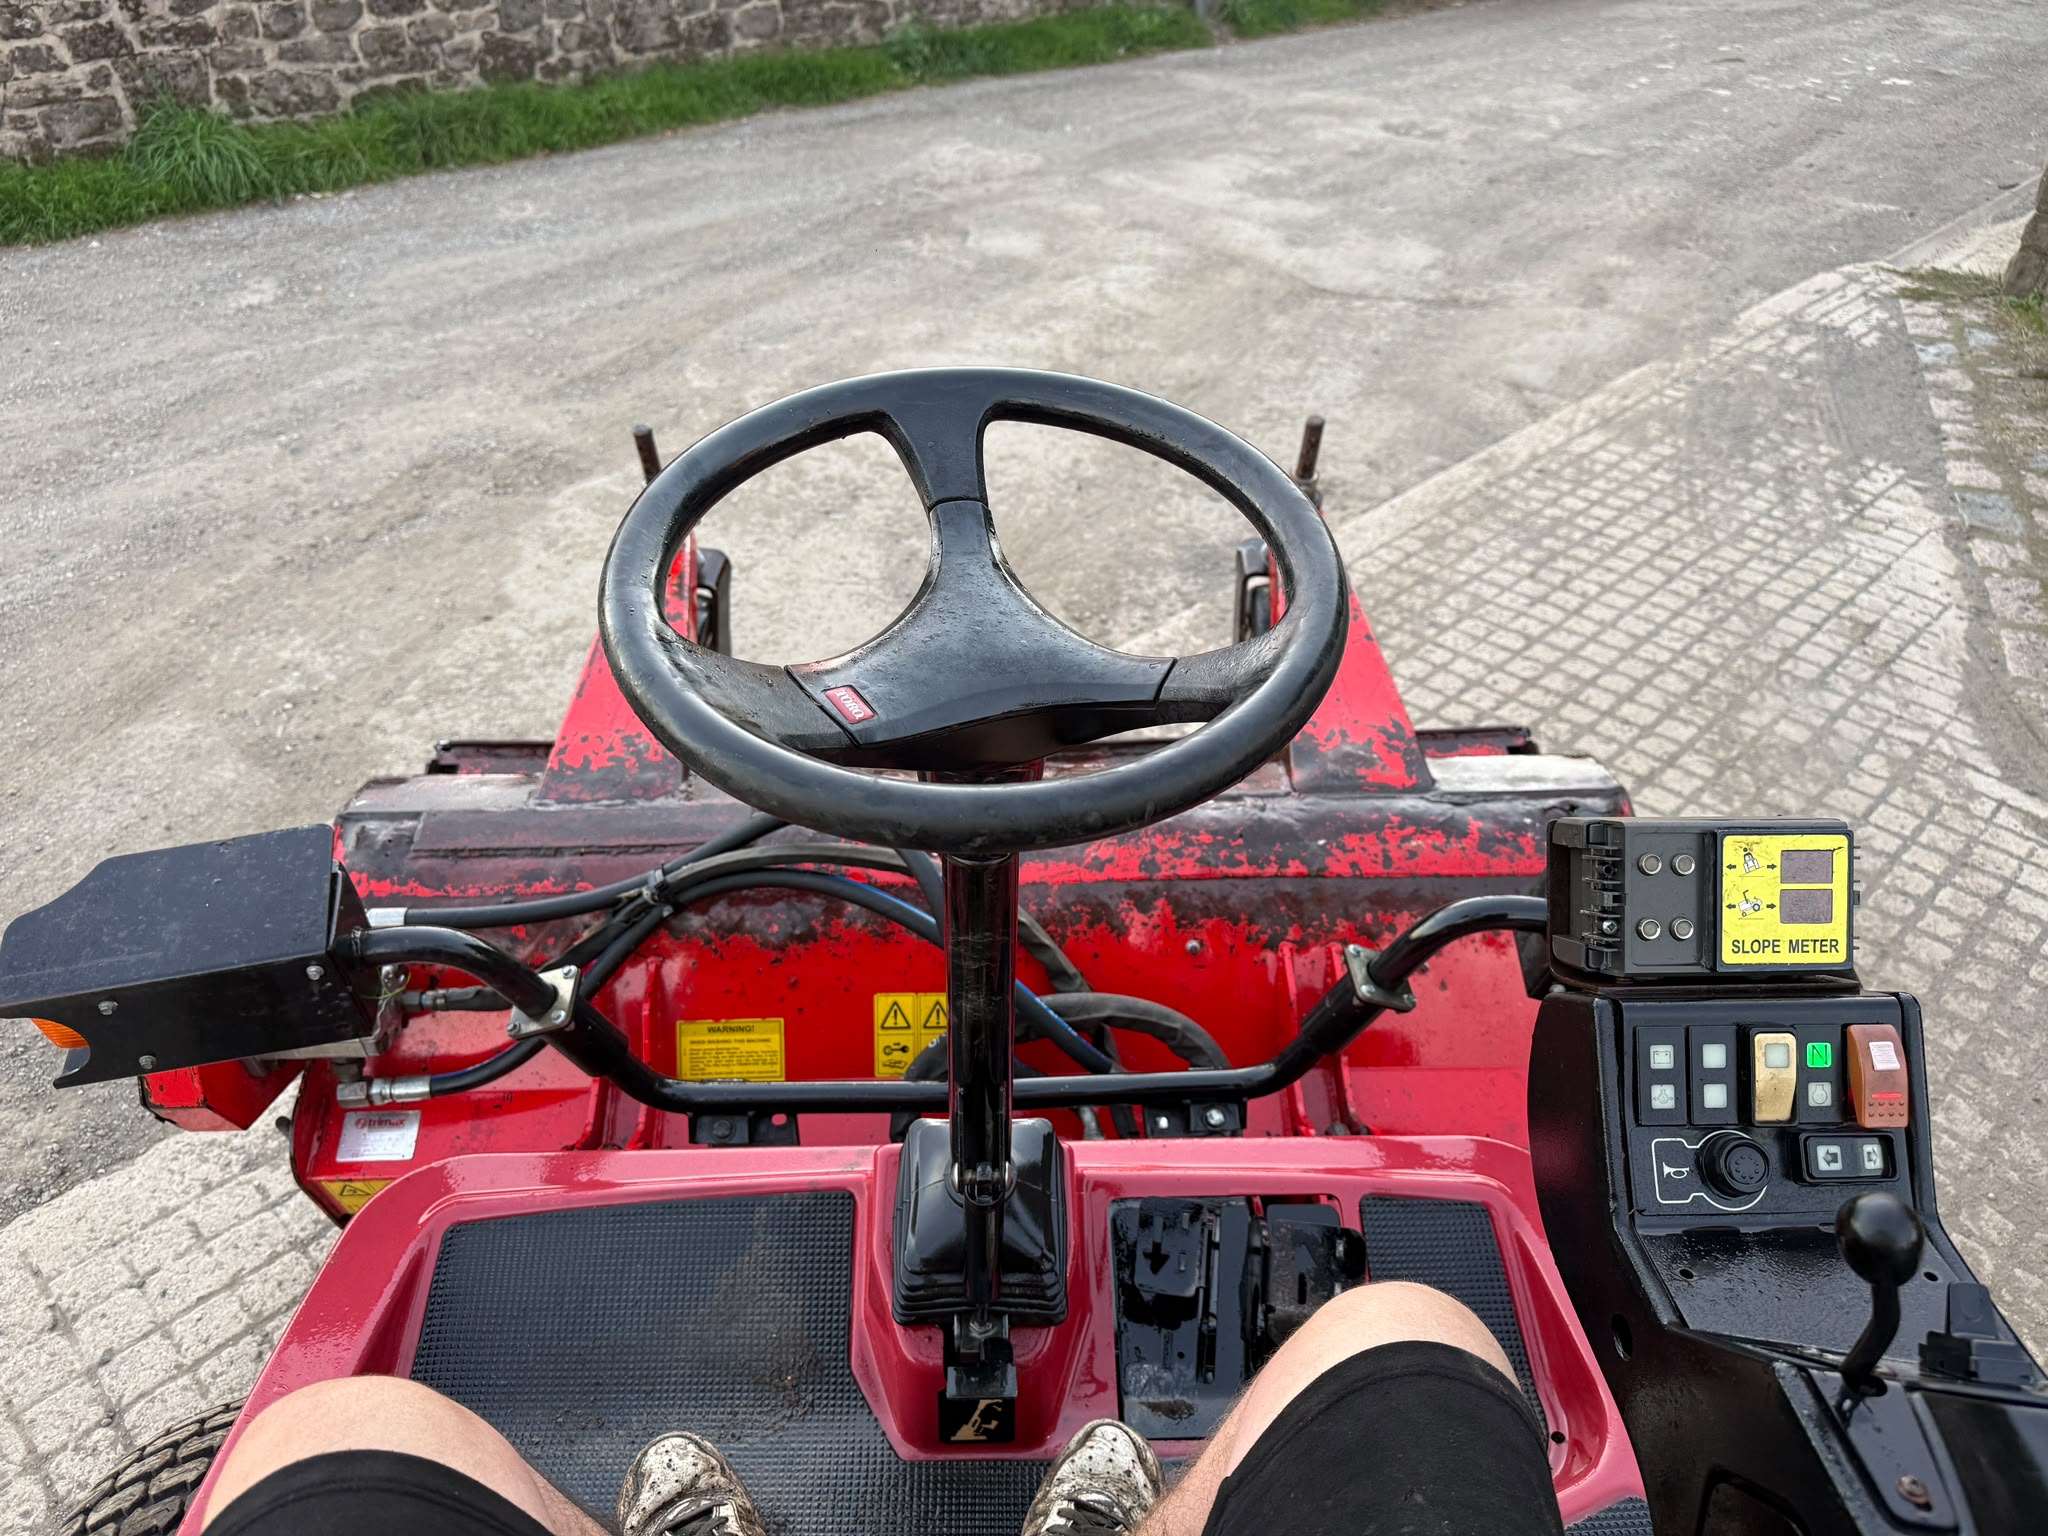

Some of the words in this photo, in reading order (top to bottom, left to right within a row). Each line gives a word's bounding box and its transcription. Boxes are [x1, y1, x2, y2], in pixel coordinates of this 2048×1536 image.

[834, 689, 865, 720] TORO
[1731, 939, 1781, 954] SLOPE
[1788, 938, 1840, 954] METER
[707, 1025, 755, 1033] WARNING!
[1811, 1044, 1828, 1066] N
